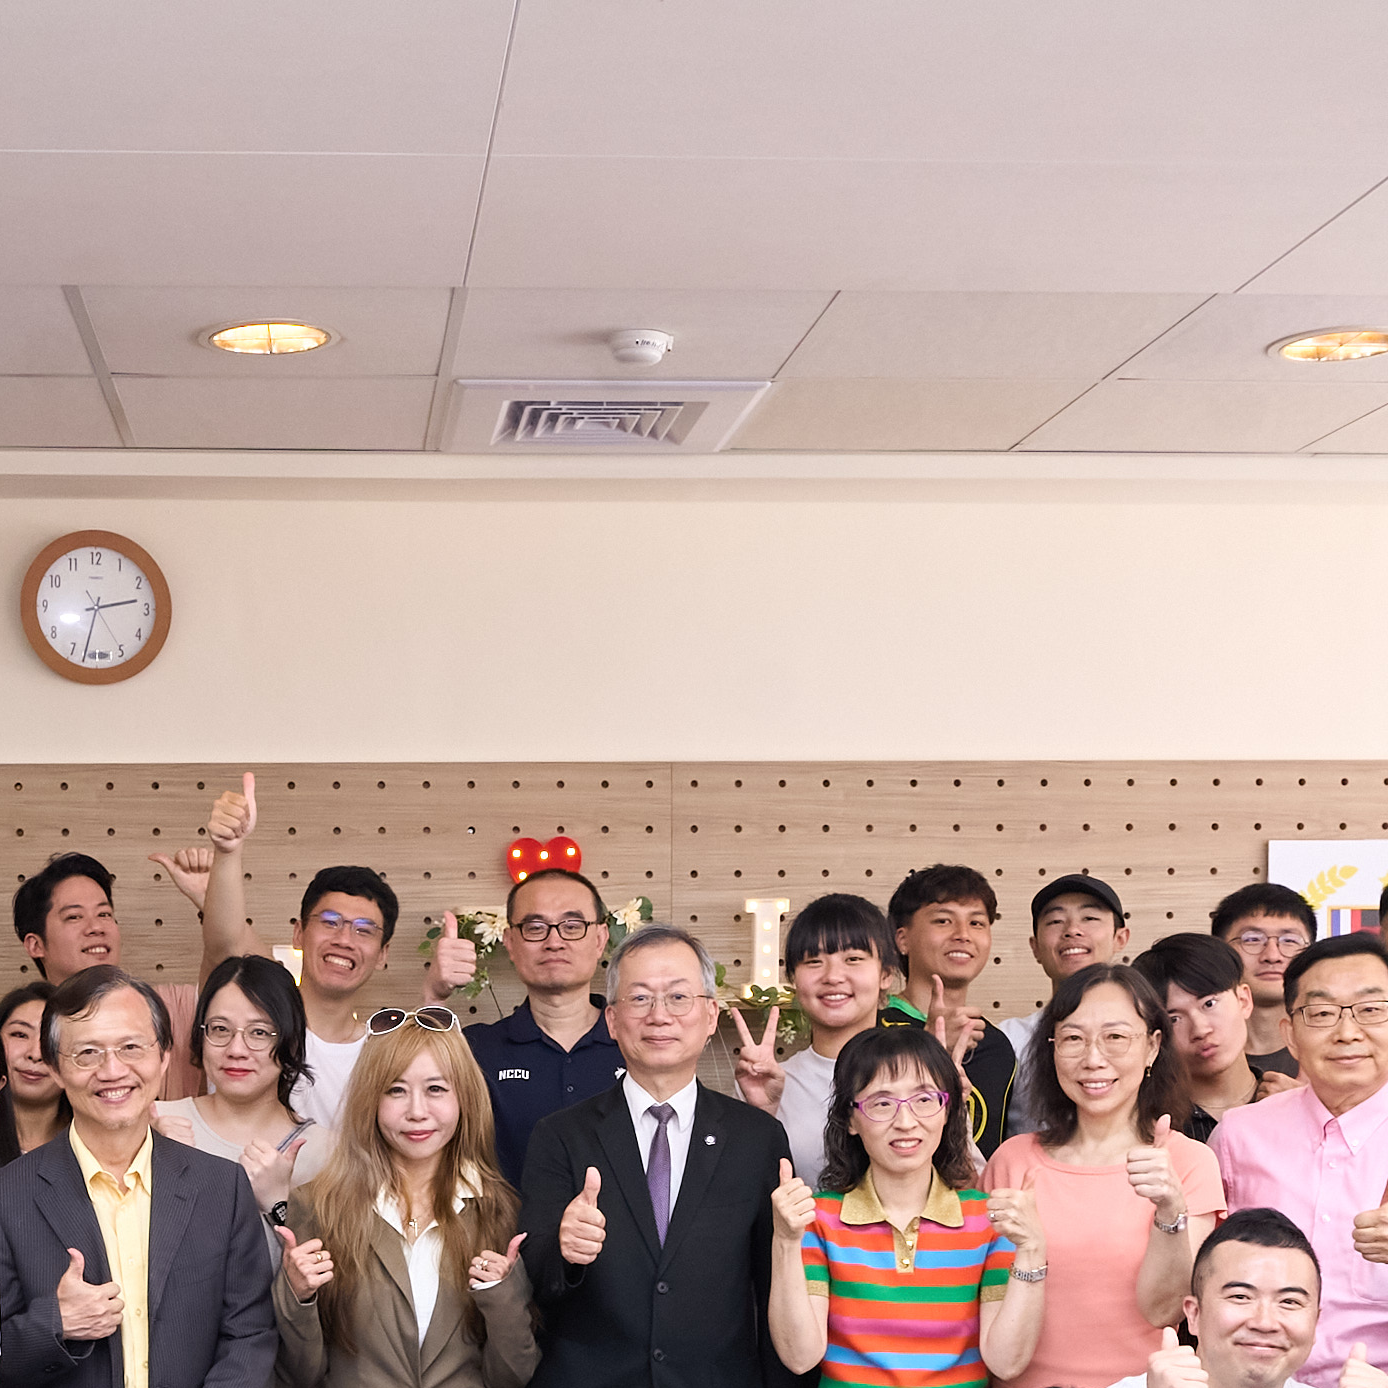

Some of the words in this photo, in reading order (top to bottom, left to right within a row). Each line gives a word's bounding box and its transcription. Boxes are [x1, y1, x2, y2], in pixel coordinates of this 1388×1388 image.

[68, 558, 77, 572] 11
[90, 551, 102, 566] 12
[50, 574, 61, 588] 10
[135, 575, 142, 590] 2
[42, 599, 48, 613] 9
[143, 603, 150, 617] 3
[50, 625, 57, 639] 8
[135, 628, 142, 641] 4
[70, 642, 76, 656] 7
[118, 644, 124, 658] 5
[498, 1068, 530, 1081] NCCU
